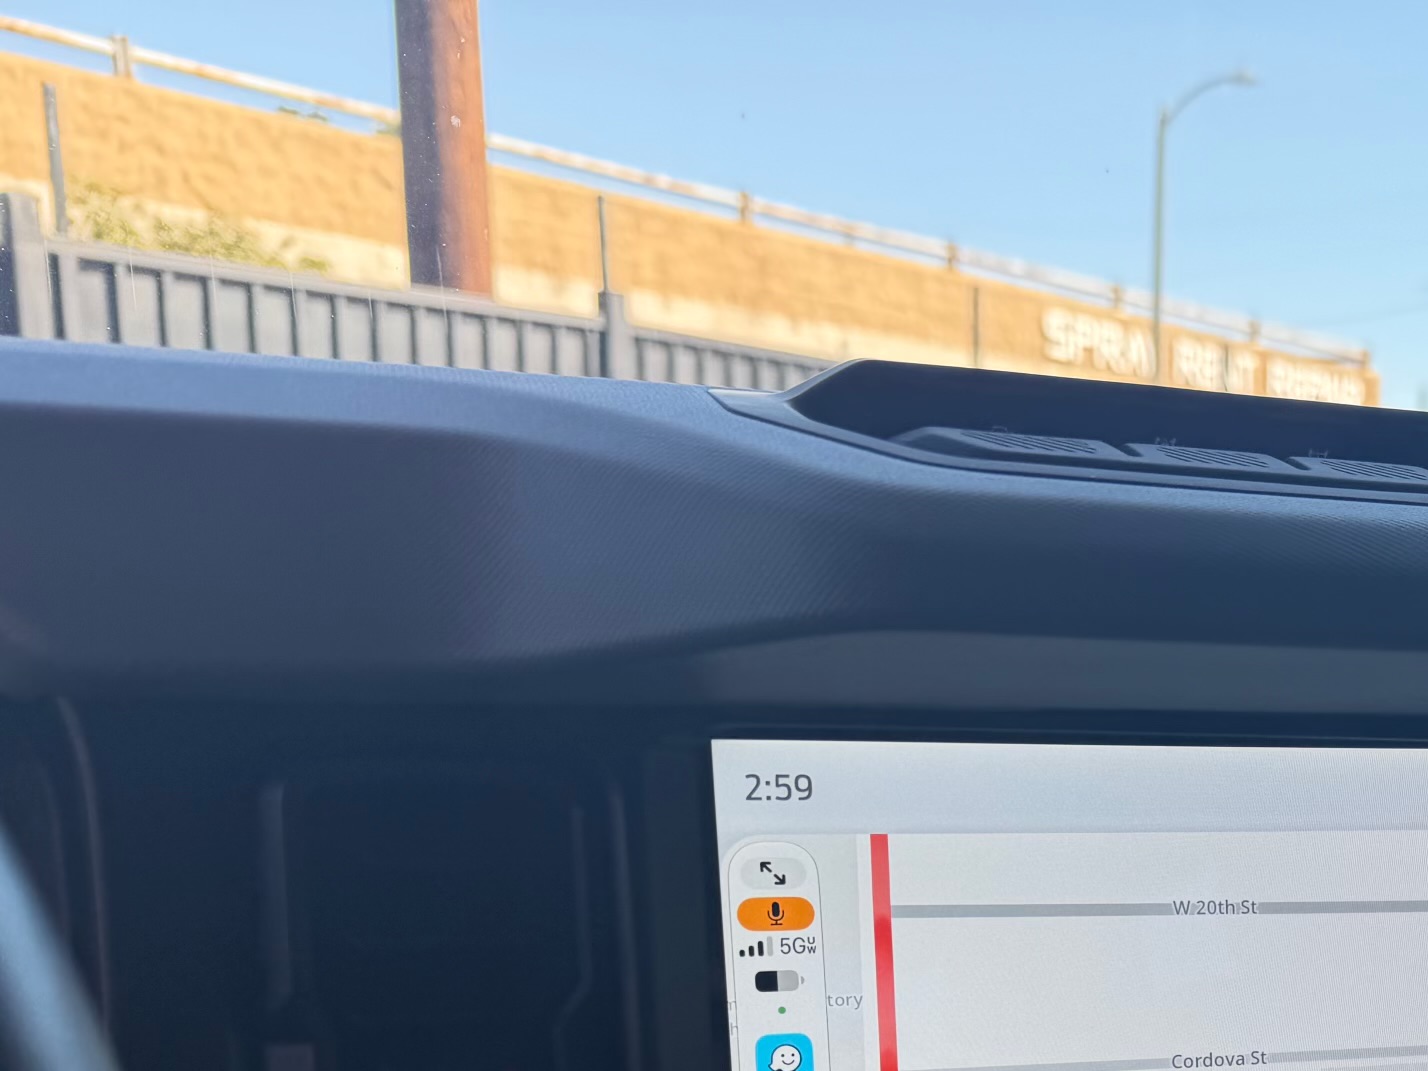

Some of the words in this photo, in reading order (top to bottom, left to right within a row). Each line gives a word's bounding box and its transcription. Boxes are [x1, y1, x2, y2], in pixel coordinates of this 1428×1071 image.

[744, 773, 814, 801] 2:59
[1172, 900, 1191, 915] W
[1196, 899, 1236, 915] 20th
[1240, 900, 1258, 915] St
[1172, 1052, 1246, 1069] Cordova
[1250, 1050, 1268, 1065] St
